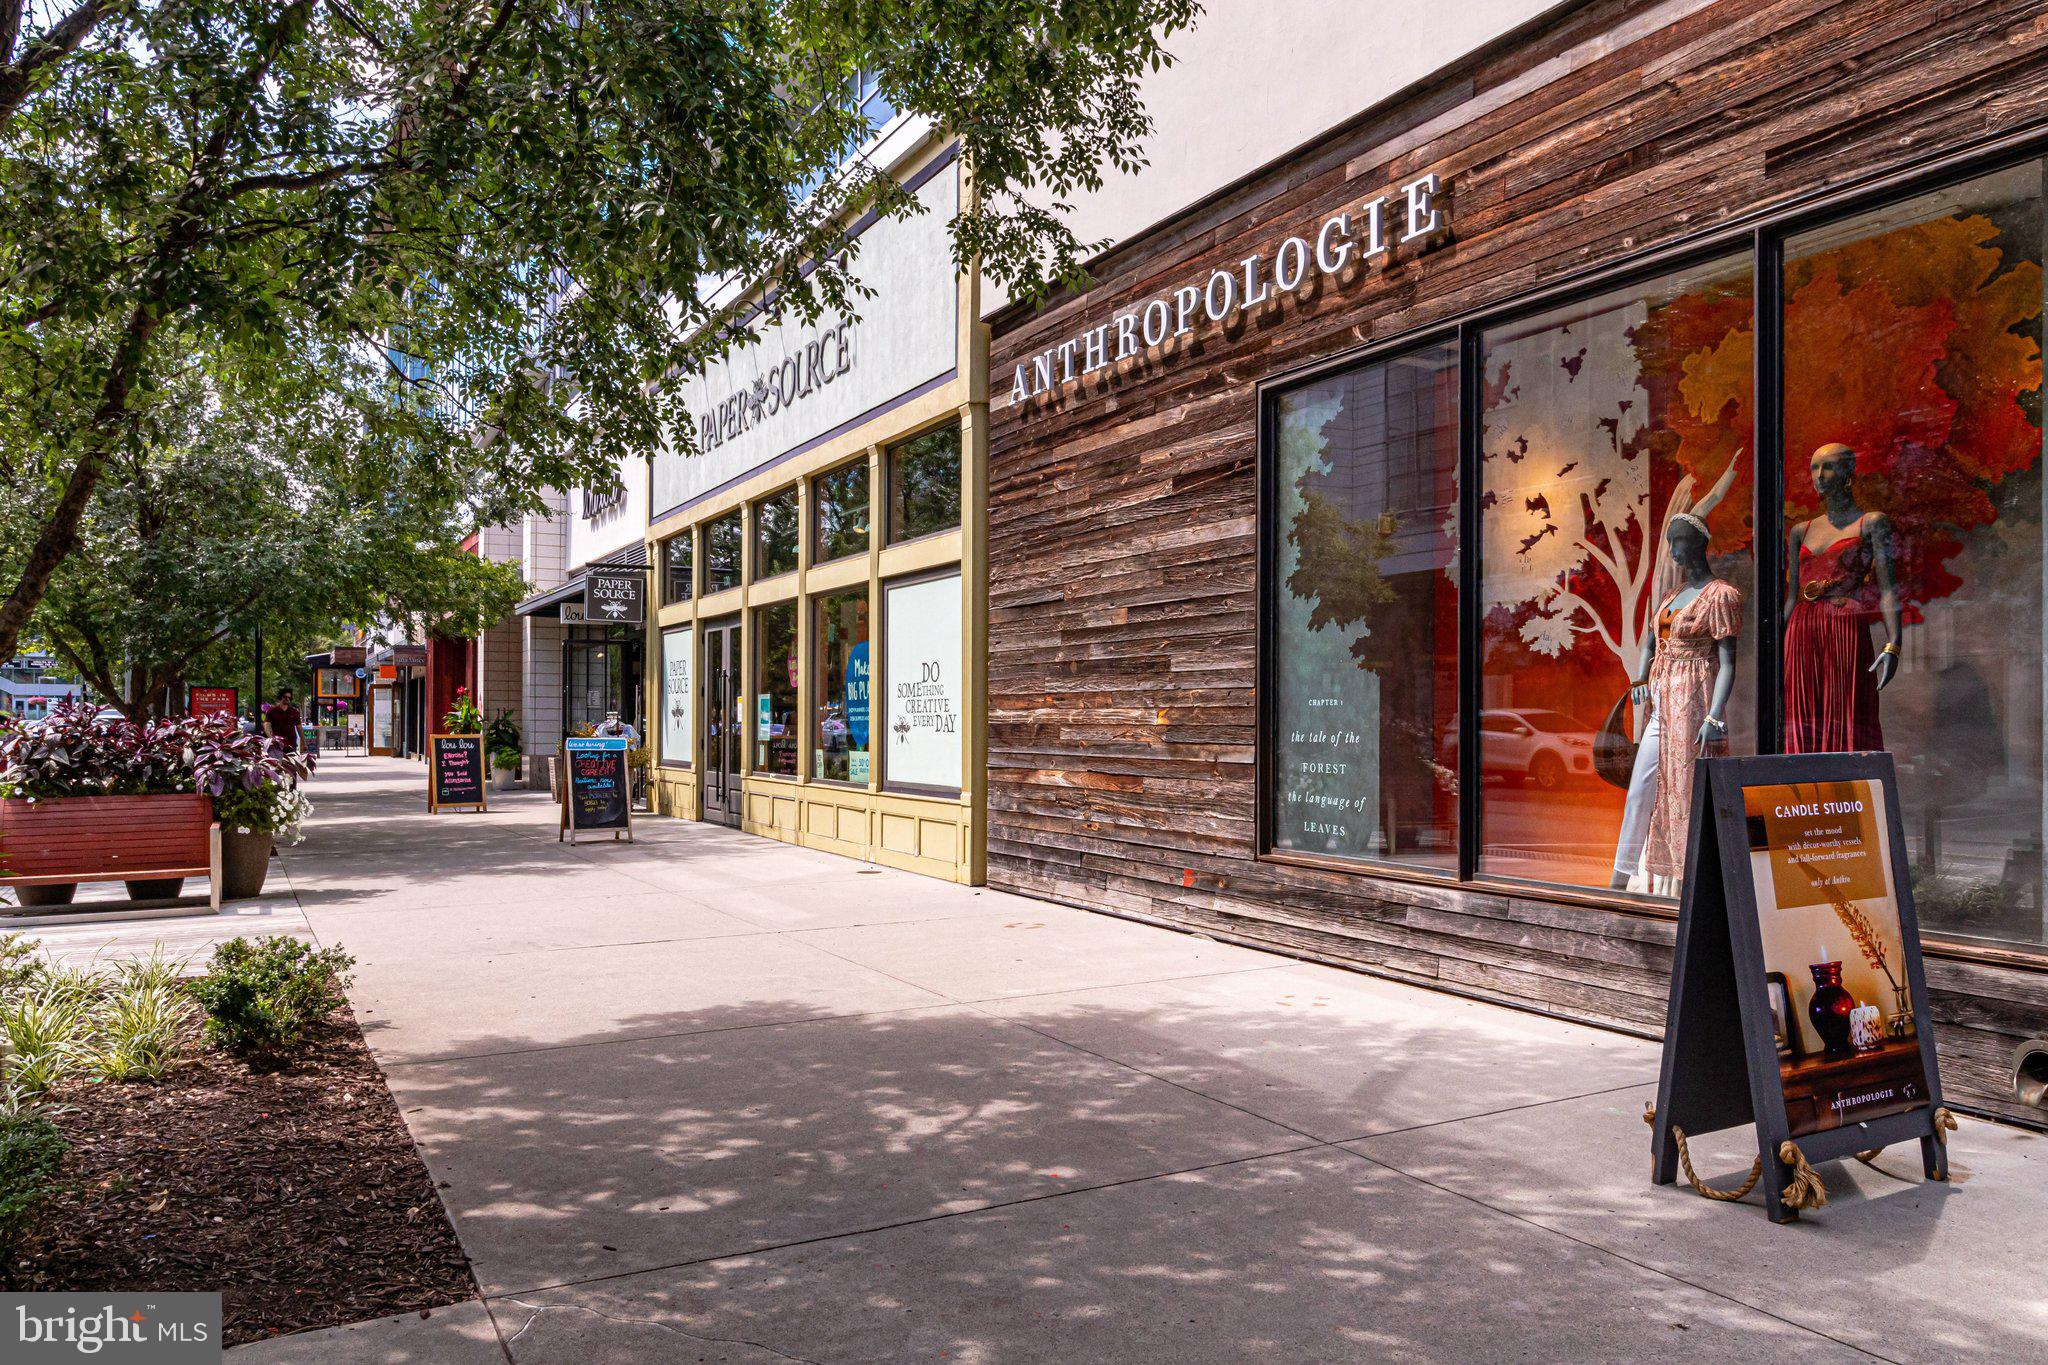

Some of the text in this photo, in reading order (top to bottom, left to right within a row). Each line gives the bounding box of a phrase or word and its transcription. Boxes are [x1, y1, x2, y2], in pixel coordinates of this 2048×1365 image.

[1008, 173, 1443, 408] ANTHROPOLOGIE
[700, 319, 851, 455] PAPER SOURCE
[597, 578, 632, 590] PAPER
[593, 588, 636, 600] SOURCE
[670, 660, 687, 676] PAPER
[921, 661, 940, 683] DO
[668, 677, 688, 694] SOURCE
[897, 682, 944, 698] SOMETHING
[905, 698, 950, 713] CREATIVE
[441, 738, 475, 749] lou lou
[1291, 731, 1360, 747] the tale of the
[1301, 762, 1347, 775] FOREST
[1287, 791, 1366, 812] the language of
[1775, 800, 1864, 818] CANDLE STUDIO
[1303, 821, 1346, 837] LEAVES
[1804, 826, 1843, 837] set the mood
[1788, 842, 1801, 851] with
[1843, 837, 1862, 846] vessels
[1787, 850, 1866, 864] and fall-forward fragrances
[1811, 878, 1823, 888] only
[1831, 875, 1851, 885] Anthro
[1831, 1088, 1894, 1110] ANTHROPOLOGIE
